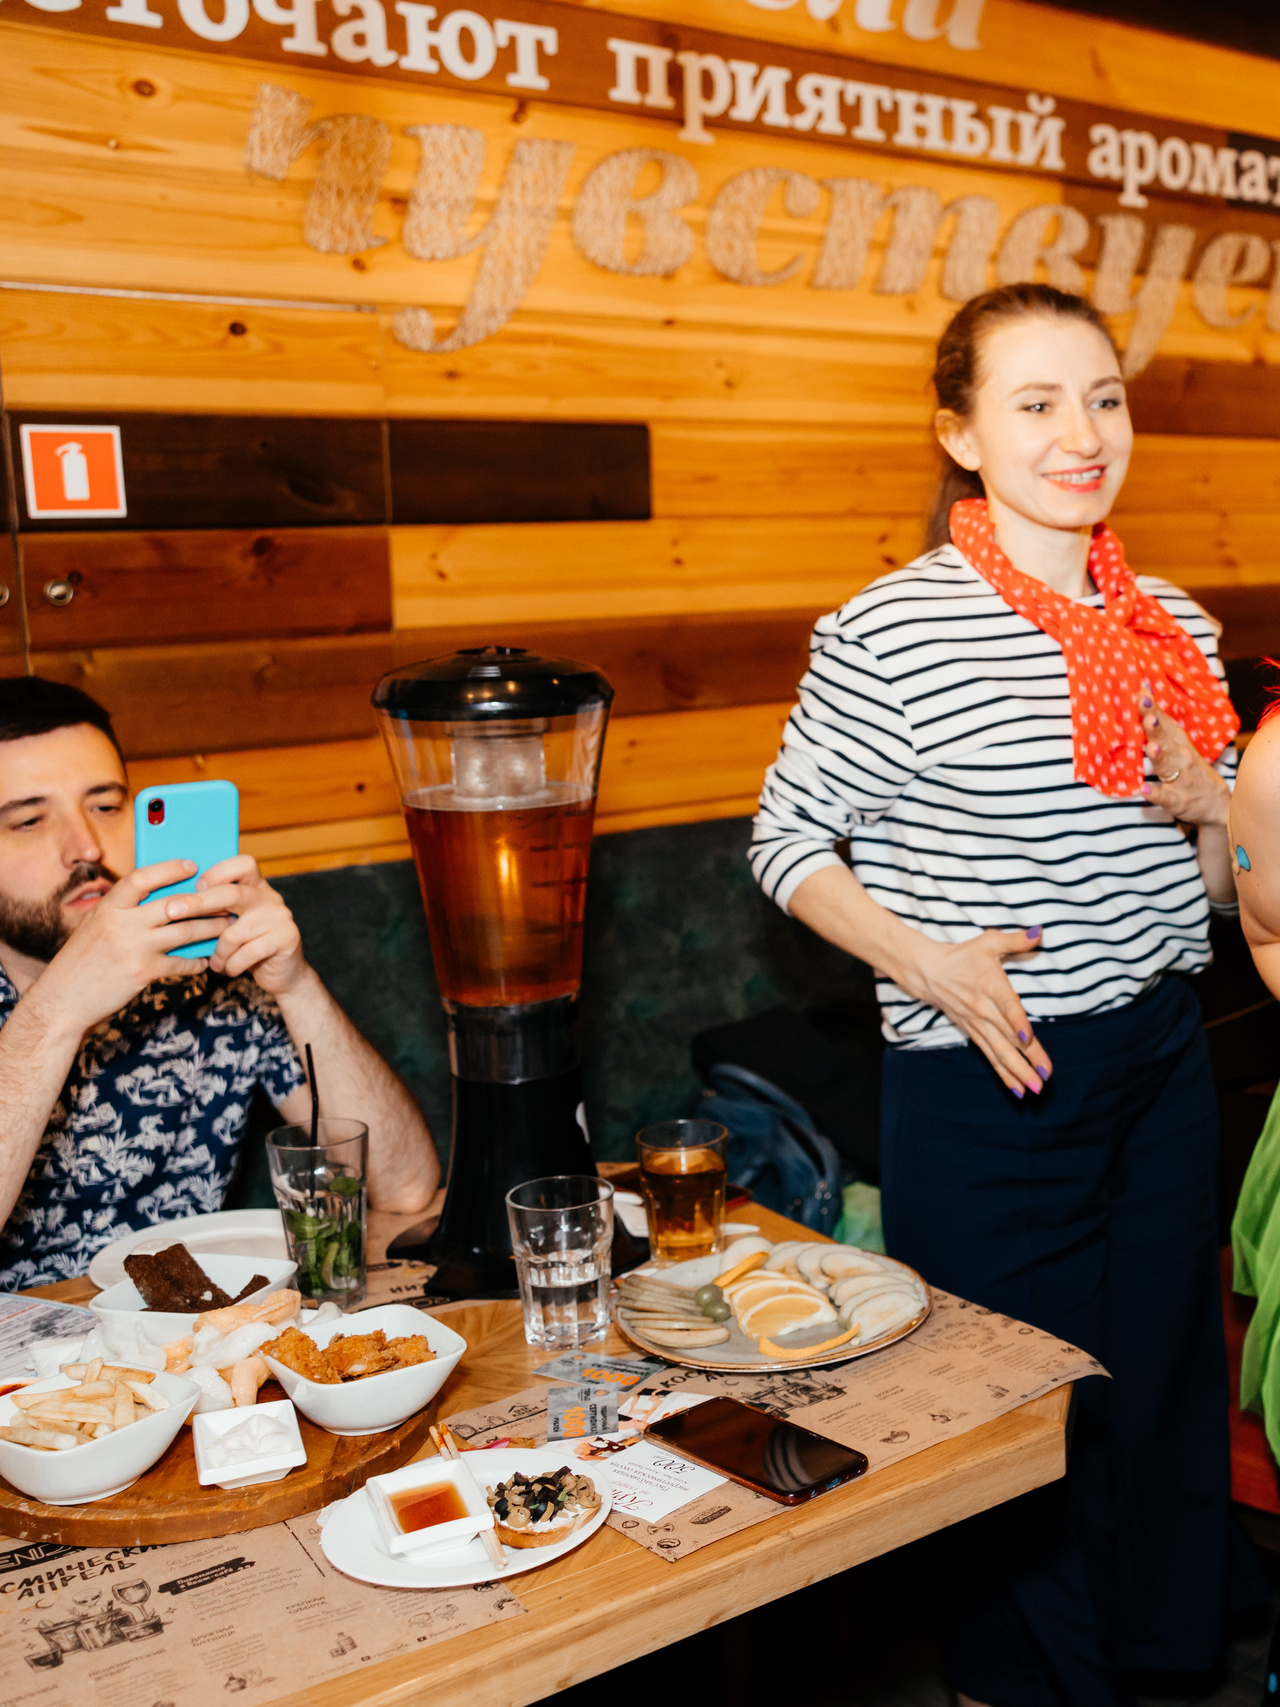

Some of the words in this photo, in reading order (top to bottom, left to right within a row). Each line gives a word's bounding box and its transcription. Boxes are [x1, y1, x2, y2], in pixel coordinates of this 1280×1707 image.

[607, 38, 1066, 172] приятный
[581, 1368, 641, 1386] 1000
[563, 1406, 586, 1437] 1000
[589, 1403, 598, 1434] СЕРТИФИКАТ
[652, 1458, 695, 1475] 500
[17, 1560, 137, 1601] АПРЕЛЬ
[176, 1565, 226, 1585] Пивомания
[285, 1596, 326, 1610] КРЕПКАЯ
[288, 1601, 328, 1615] СУББОТА
[190, 1624, 235, 1643] ДРУЖНАЯ
[192, 1630, 237, 1648] ПЯТНИЦА
